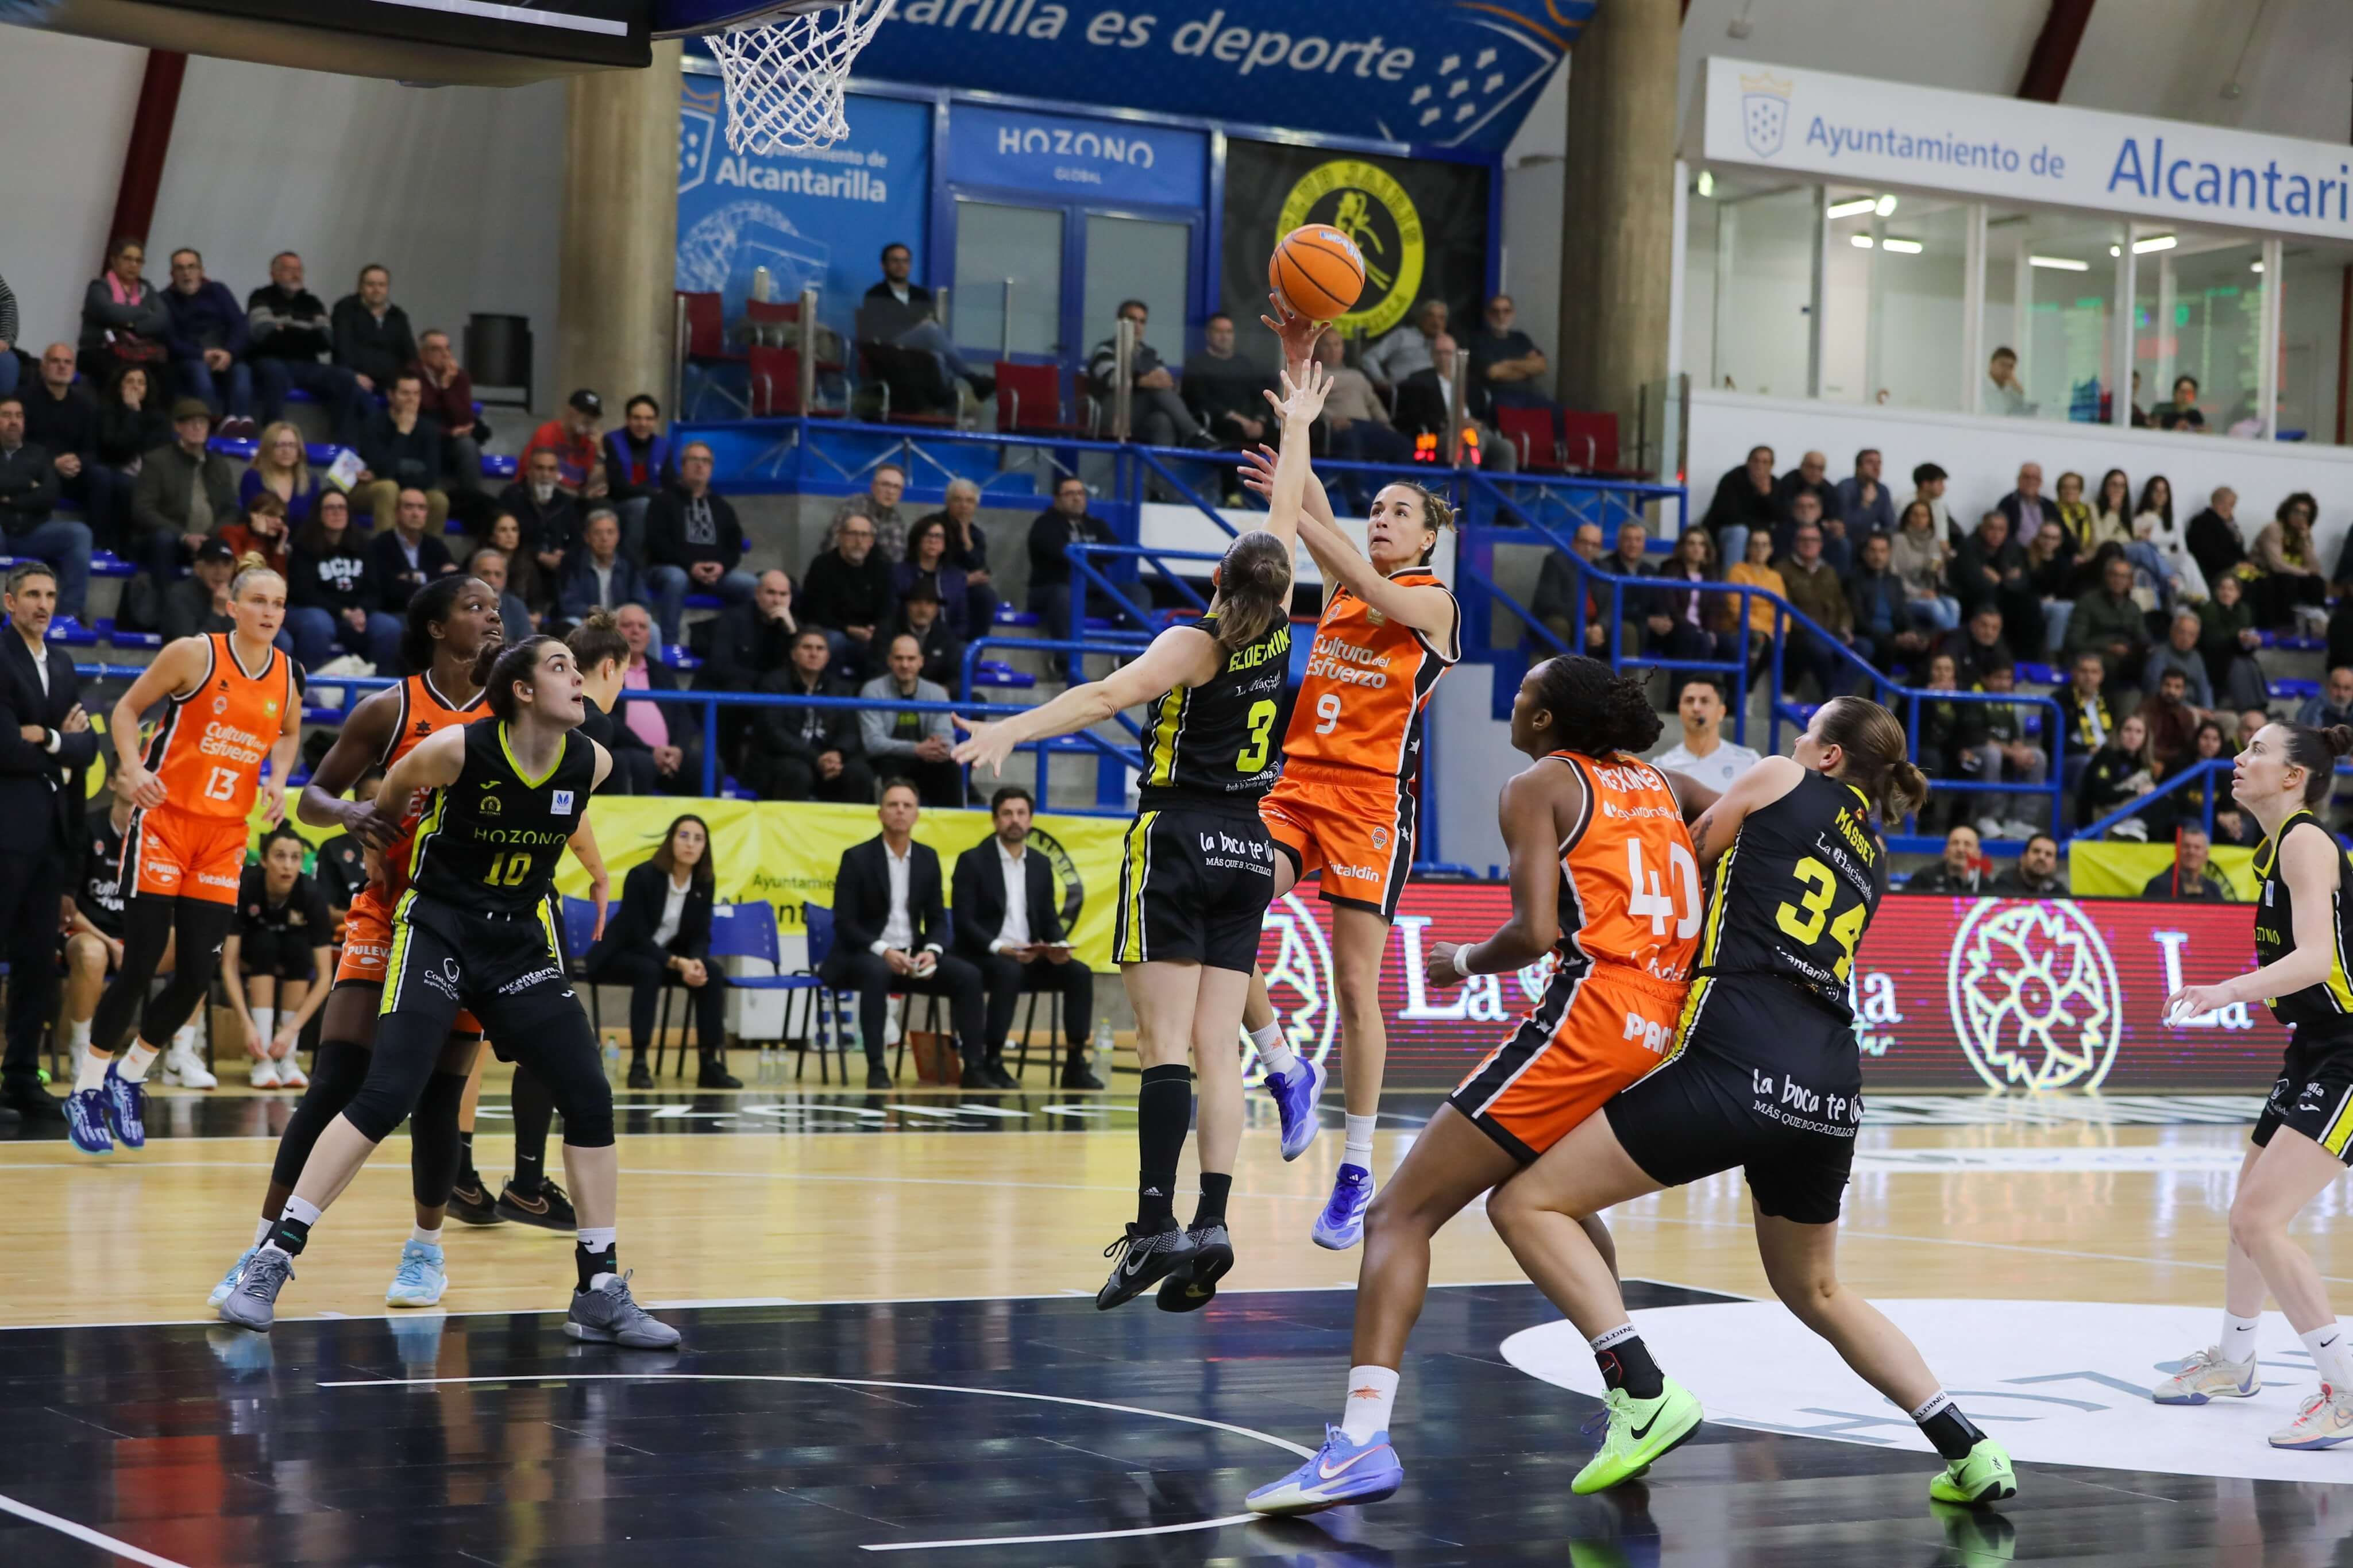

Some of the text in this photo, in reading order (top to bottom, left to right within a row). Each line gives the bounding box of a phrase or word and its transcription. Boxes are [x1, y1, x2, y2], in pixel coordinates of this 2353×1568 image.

[1086, 9, 1156, 48] es
[1171, 9, 1415, 79] deporte
[999, 128, 1154, 169] HOZONO
[1806, 116, 2348, 222] Ayuntamiento de Alcantari
[715, 156, 887, 202] Alcantarilla
[1306, 654, 1387, 689] Esfuerzo
[1313, 634, 1390, 667] Cultura del
[1315, 693, 1341, 735] 9
[1236, 699, 1277, 773] 3
[205, 766, 240, 801] 13
[474, 827, 566, 844] HOZONO
[1200, 832, 1214, 852] la
[1248, 840, 1263, 859] te
[1835, 806, 1875, 868] MASSEY
[483, 852, 531, 886] 10
[1206, 856, 1224, 866] MÁS
[1225, 859, 1239, 868] QUE
[1815, 831, 1831, 855] La
[1833, 847, 1872, 901] Hacienda
[1628, 838, 1704, 940] 40
[1776, 856, 1867, 982] 34
[347, 945, 391, 959] PULEV
[1392, 915, 1510, 1022] La
[1753, 1068, 1773, 1094] la
[1781, 1074, 1819, 1112] boca
[1827, 1093, 1846, 1120] te
[1753, 1099, 1855, 1137] MÁS QUE BOCADILLOS
